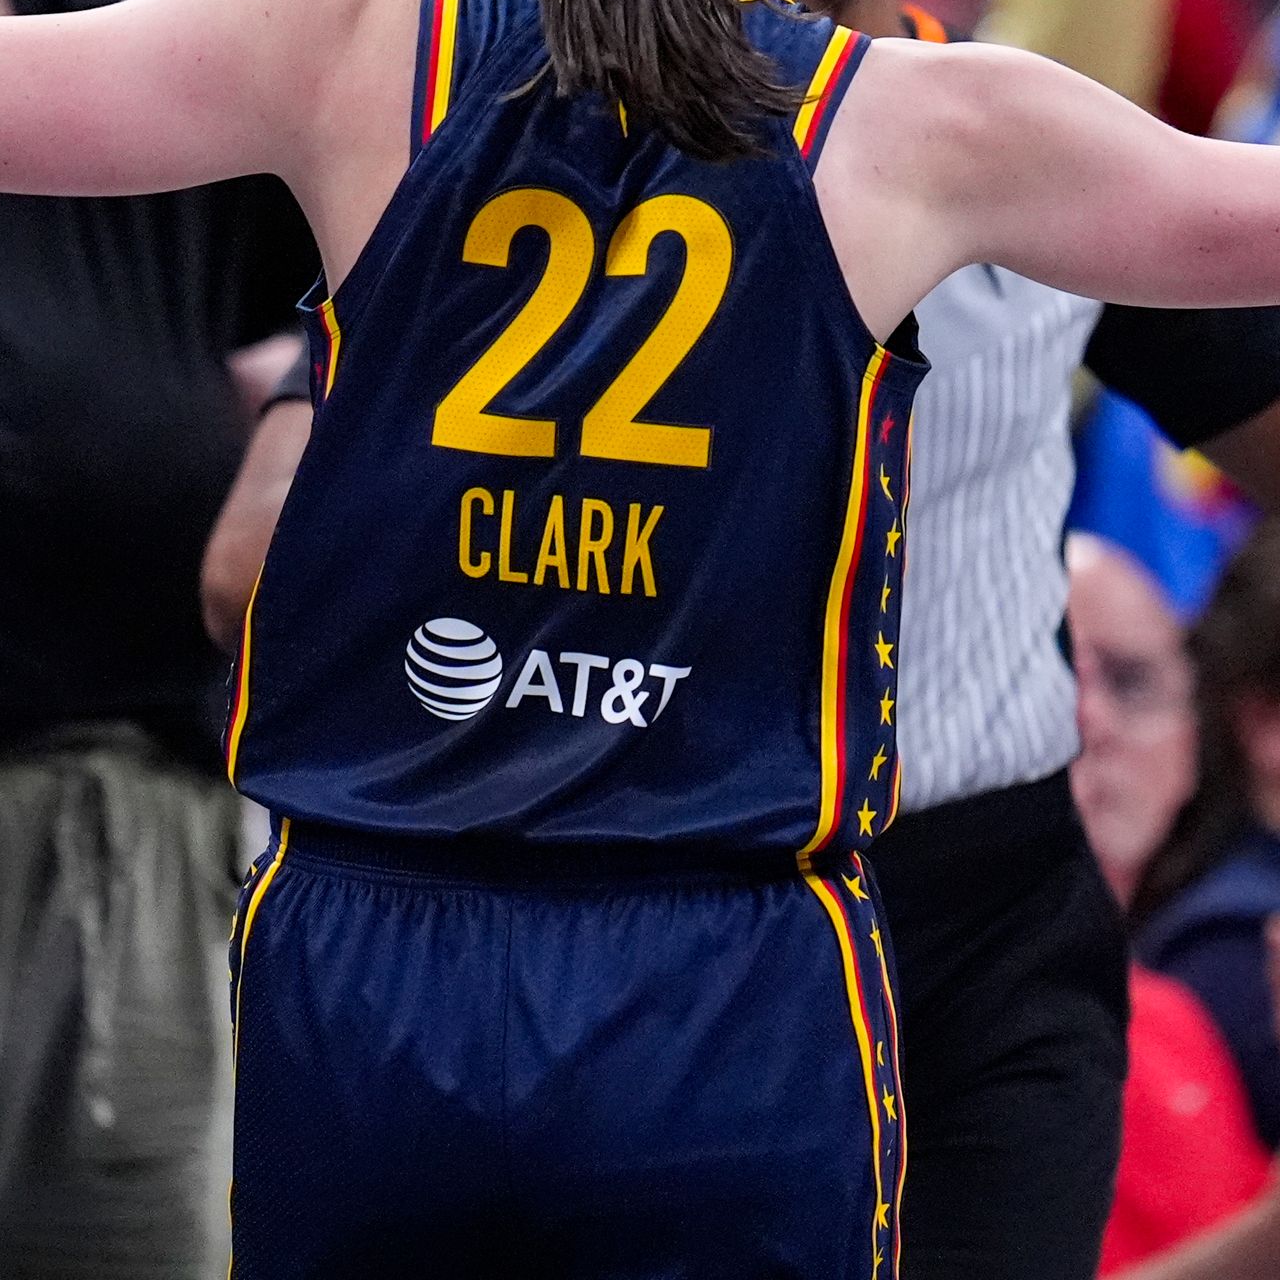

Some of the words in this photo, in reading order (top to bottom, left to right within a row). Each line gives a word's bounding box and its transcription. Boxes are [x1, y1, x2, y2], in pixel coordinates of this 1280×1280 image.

[431, 187, 733, 468] 22
[458, 486, 665, 598] CLARK
[505, 648, 693, 728] AT&T
